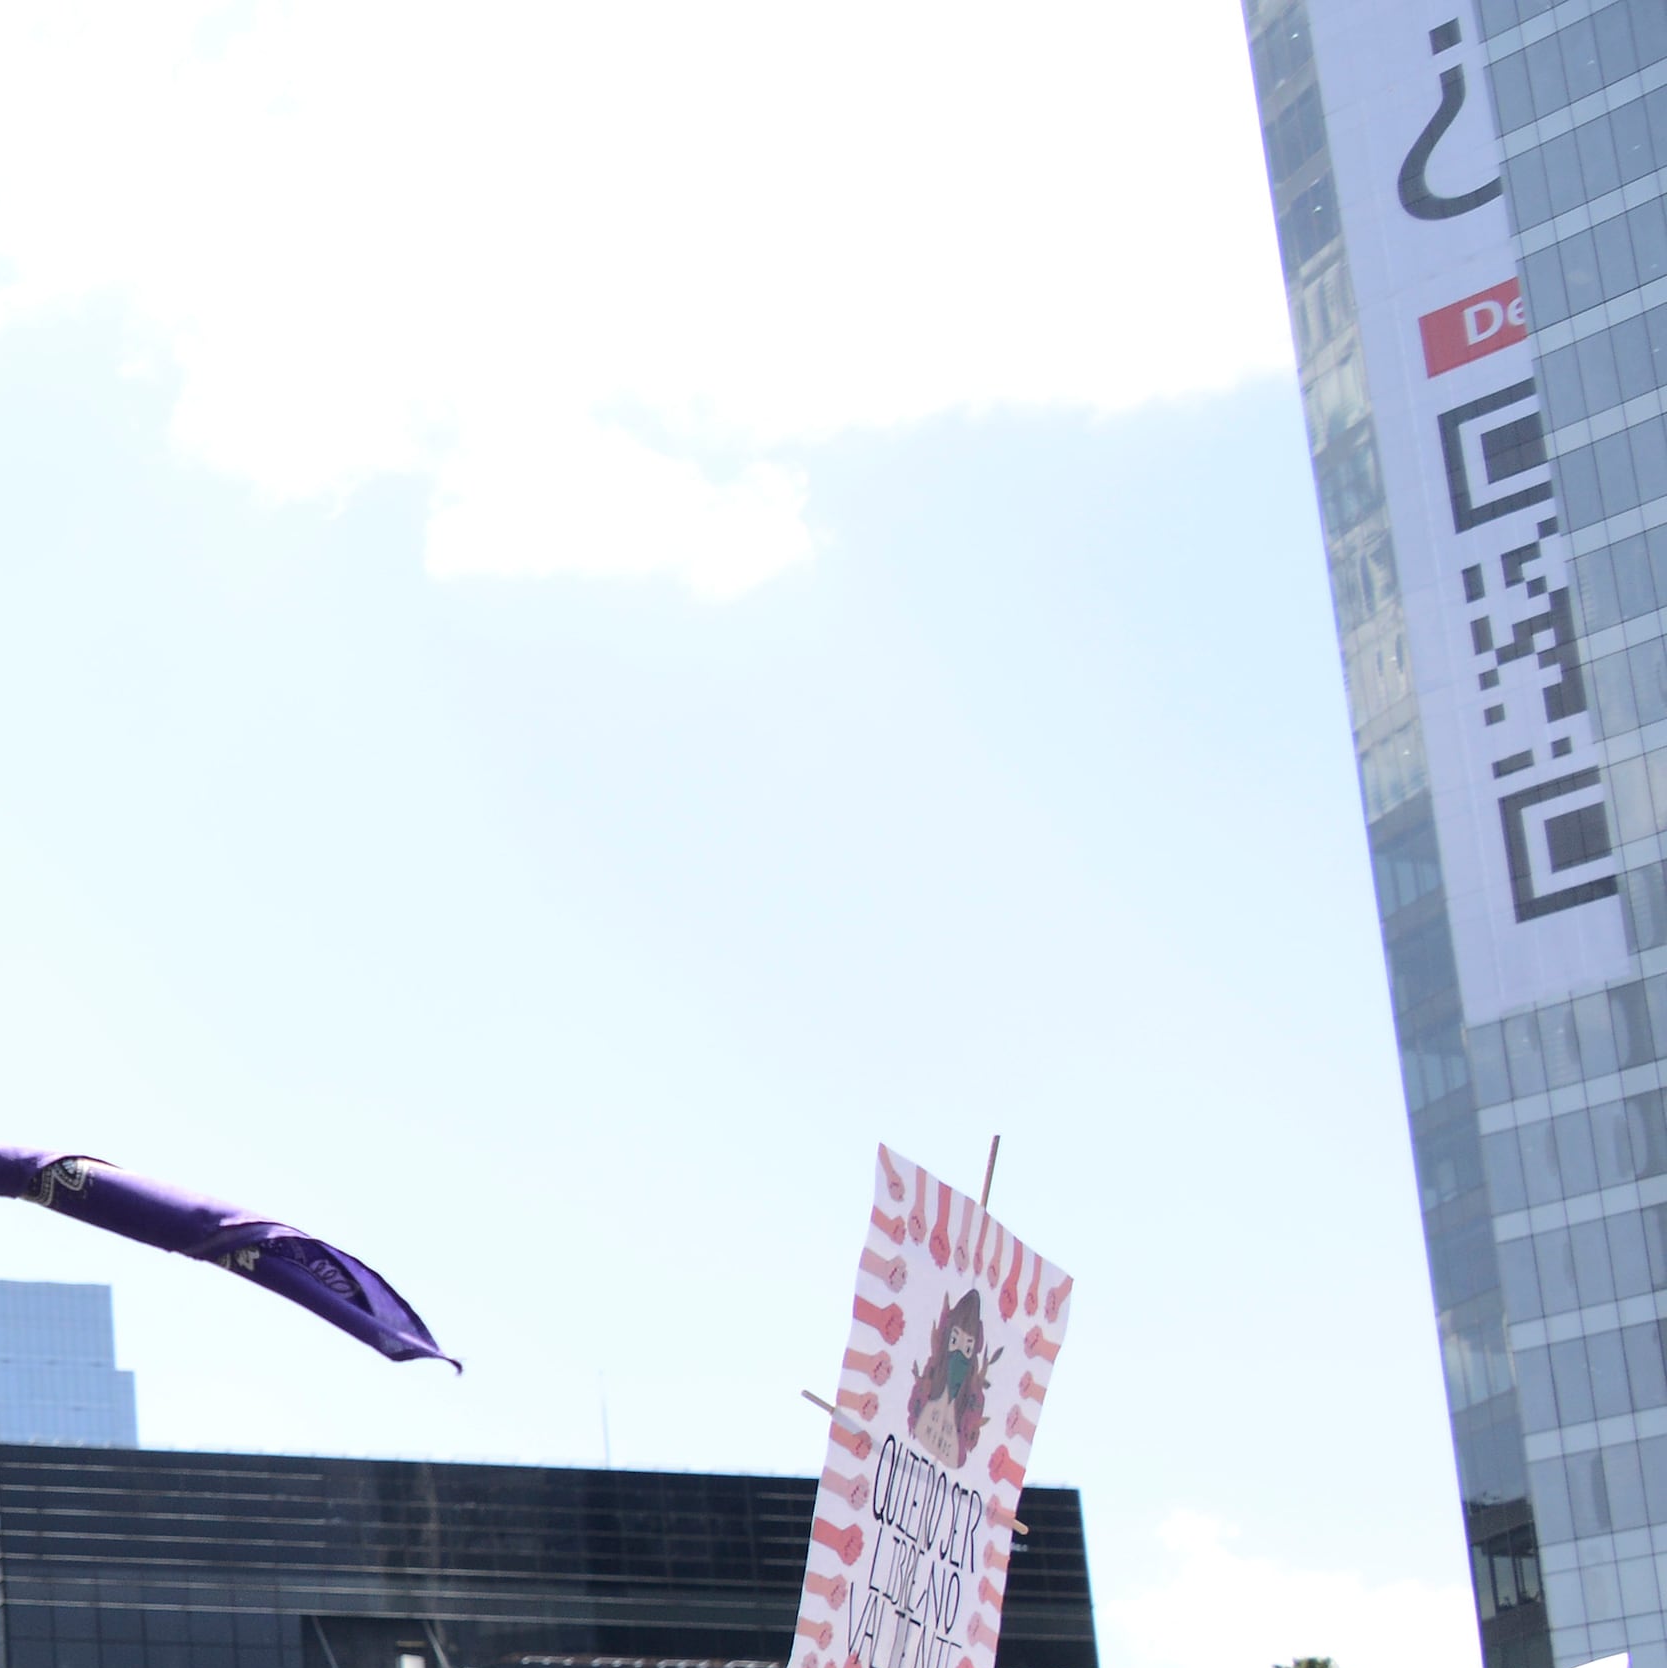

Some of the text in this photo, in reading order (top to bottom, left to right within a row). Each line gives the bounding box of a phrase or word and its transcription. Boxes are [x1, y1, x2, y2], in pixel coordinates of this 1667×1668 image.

[873, 1434, 982, 1573] QUIERO SER
[915, 1560, 960, 1635] NO
